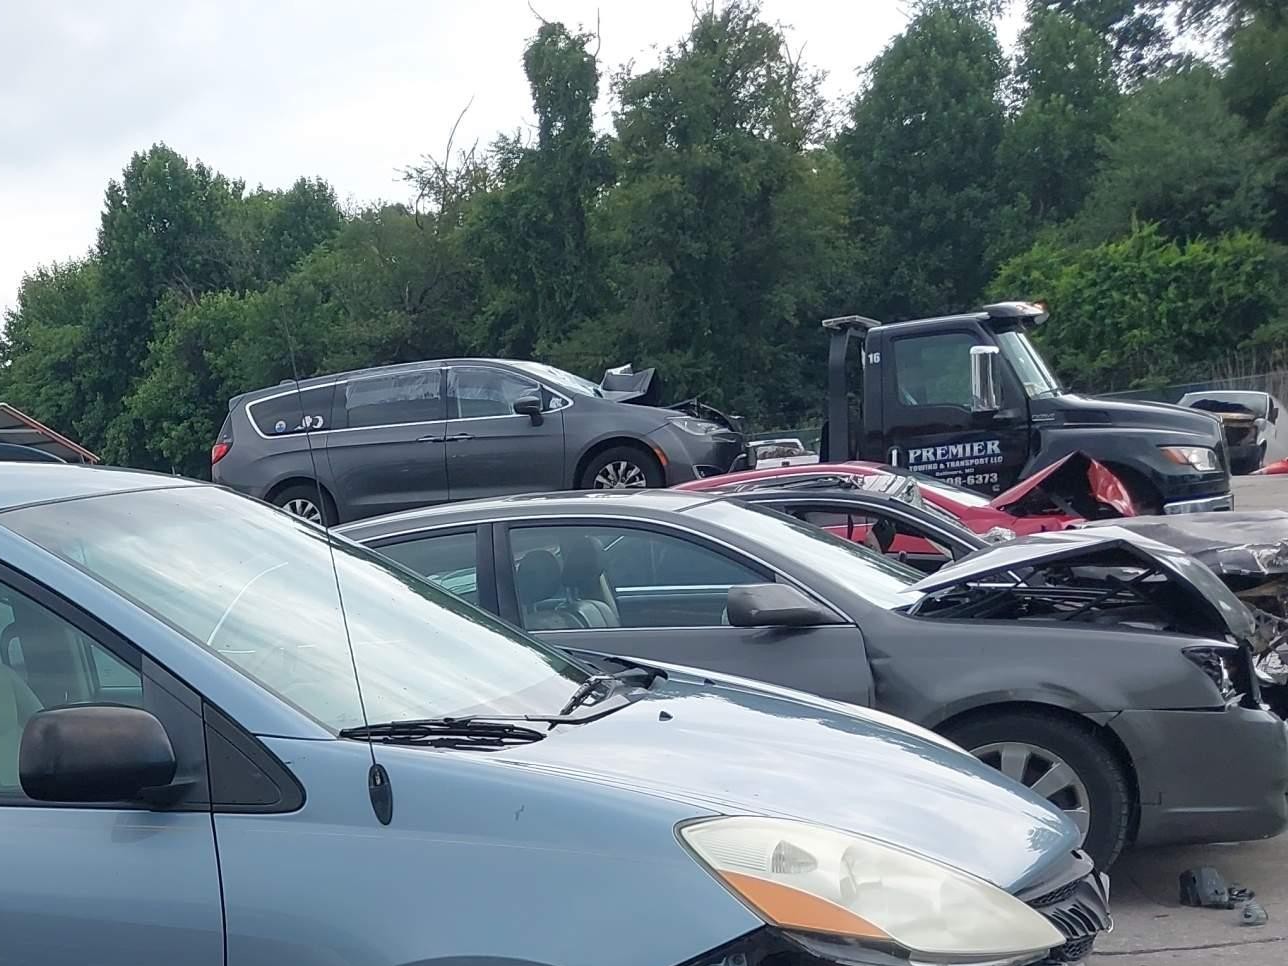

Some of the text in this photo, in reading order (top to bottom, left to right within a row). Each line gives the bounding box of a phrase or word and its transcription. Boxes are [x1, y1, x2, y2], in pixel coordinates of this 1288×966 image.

[868, 352, 881, 364] 16
[908, 440, 1000, 463] PREMIER
[946, 457, 989, 468] TRANSPORT
